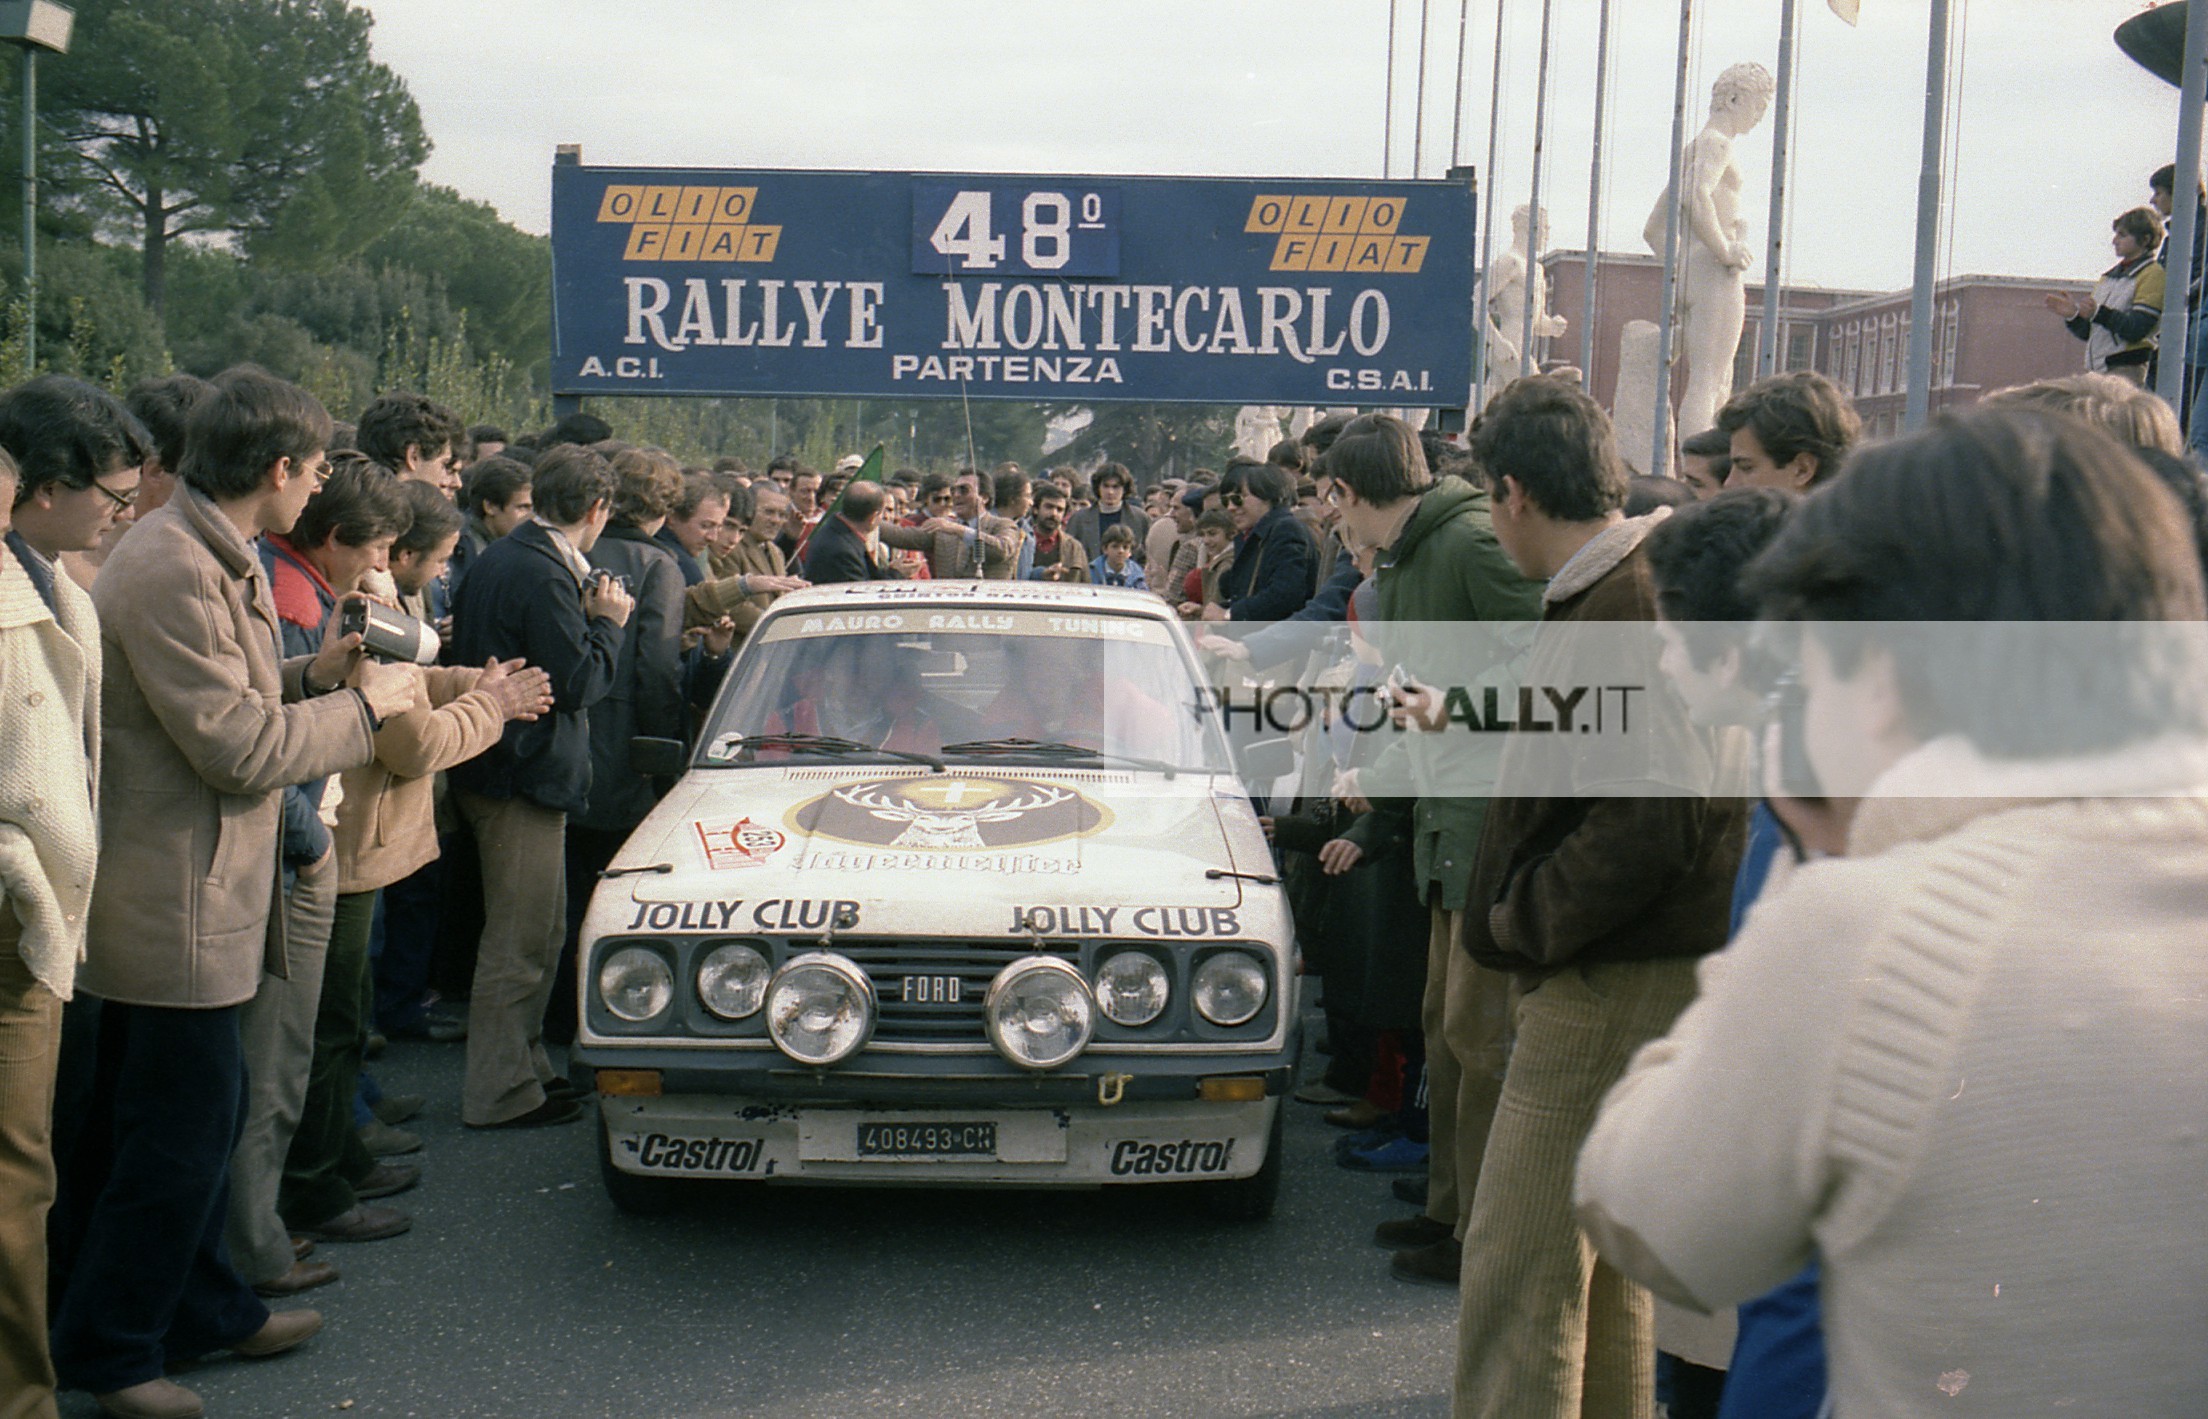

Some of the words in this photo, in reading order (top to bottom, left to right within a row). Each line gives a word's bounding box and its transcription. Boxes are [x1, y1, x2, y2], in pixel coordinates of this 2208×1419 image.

[610, 192, 747, 218] OLIO
[1258, 201, 1395, 228] OLIO
[635, 231, 773, 256] FIAT
[1283, 241, 1421, 266] FIAT
[623, 277, 884, 352] RALLYE
[942, 282, 1391, 364] MONTECARLO
[579, 356, 664, 379] A.C.I.
[892, 355, 1124, 384] PARTENZA
[1326, 369, 1434, 391] C.S.A.I.
[801, 615, 903, 633] MAURO
[929, 615, 1014, 630] RALLY
[1048, 618, 1144, 637] TUNING
[627, 900, 744, 930] JOLLY
[753, 899, 860, 930] CLUB
[1008, 906, 1118, 934] JOLLY
[1133, 907, 1241, 936] CLUB
[903, 976, 960, 1002] FORD
[865, 1128, 952, 1149] 408493
[640, 1133, 764, 1172] Castrol
[1110, 1137, 1235, 1175] Castrol
